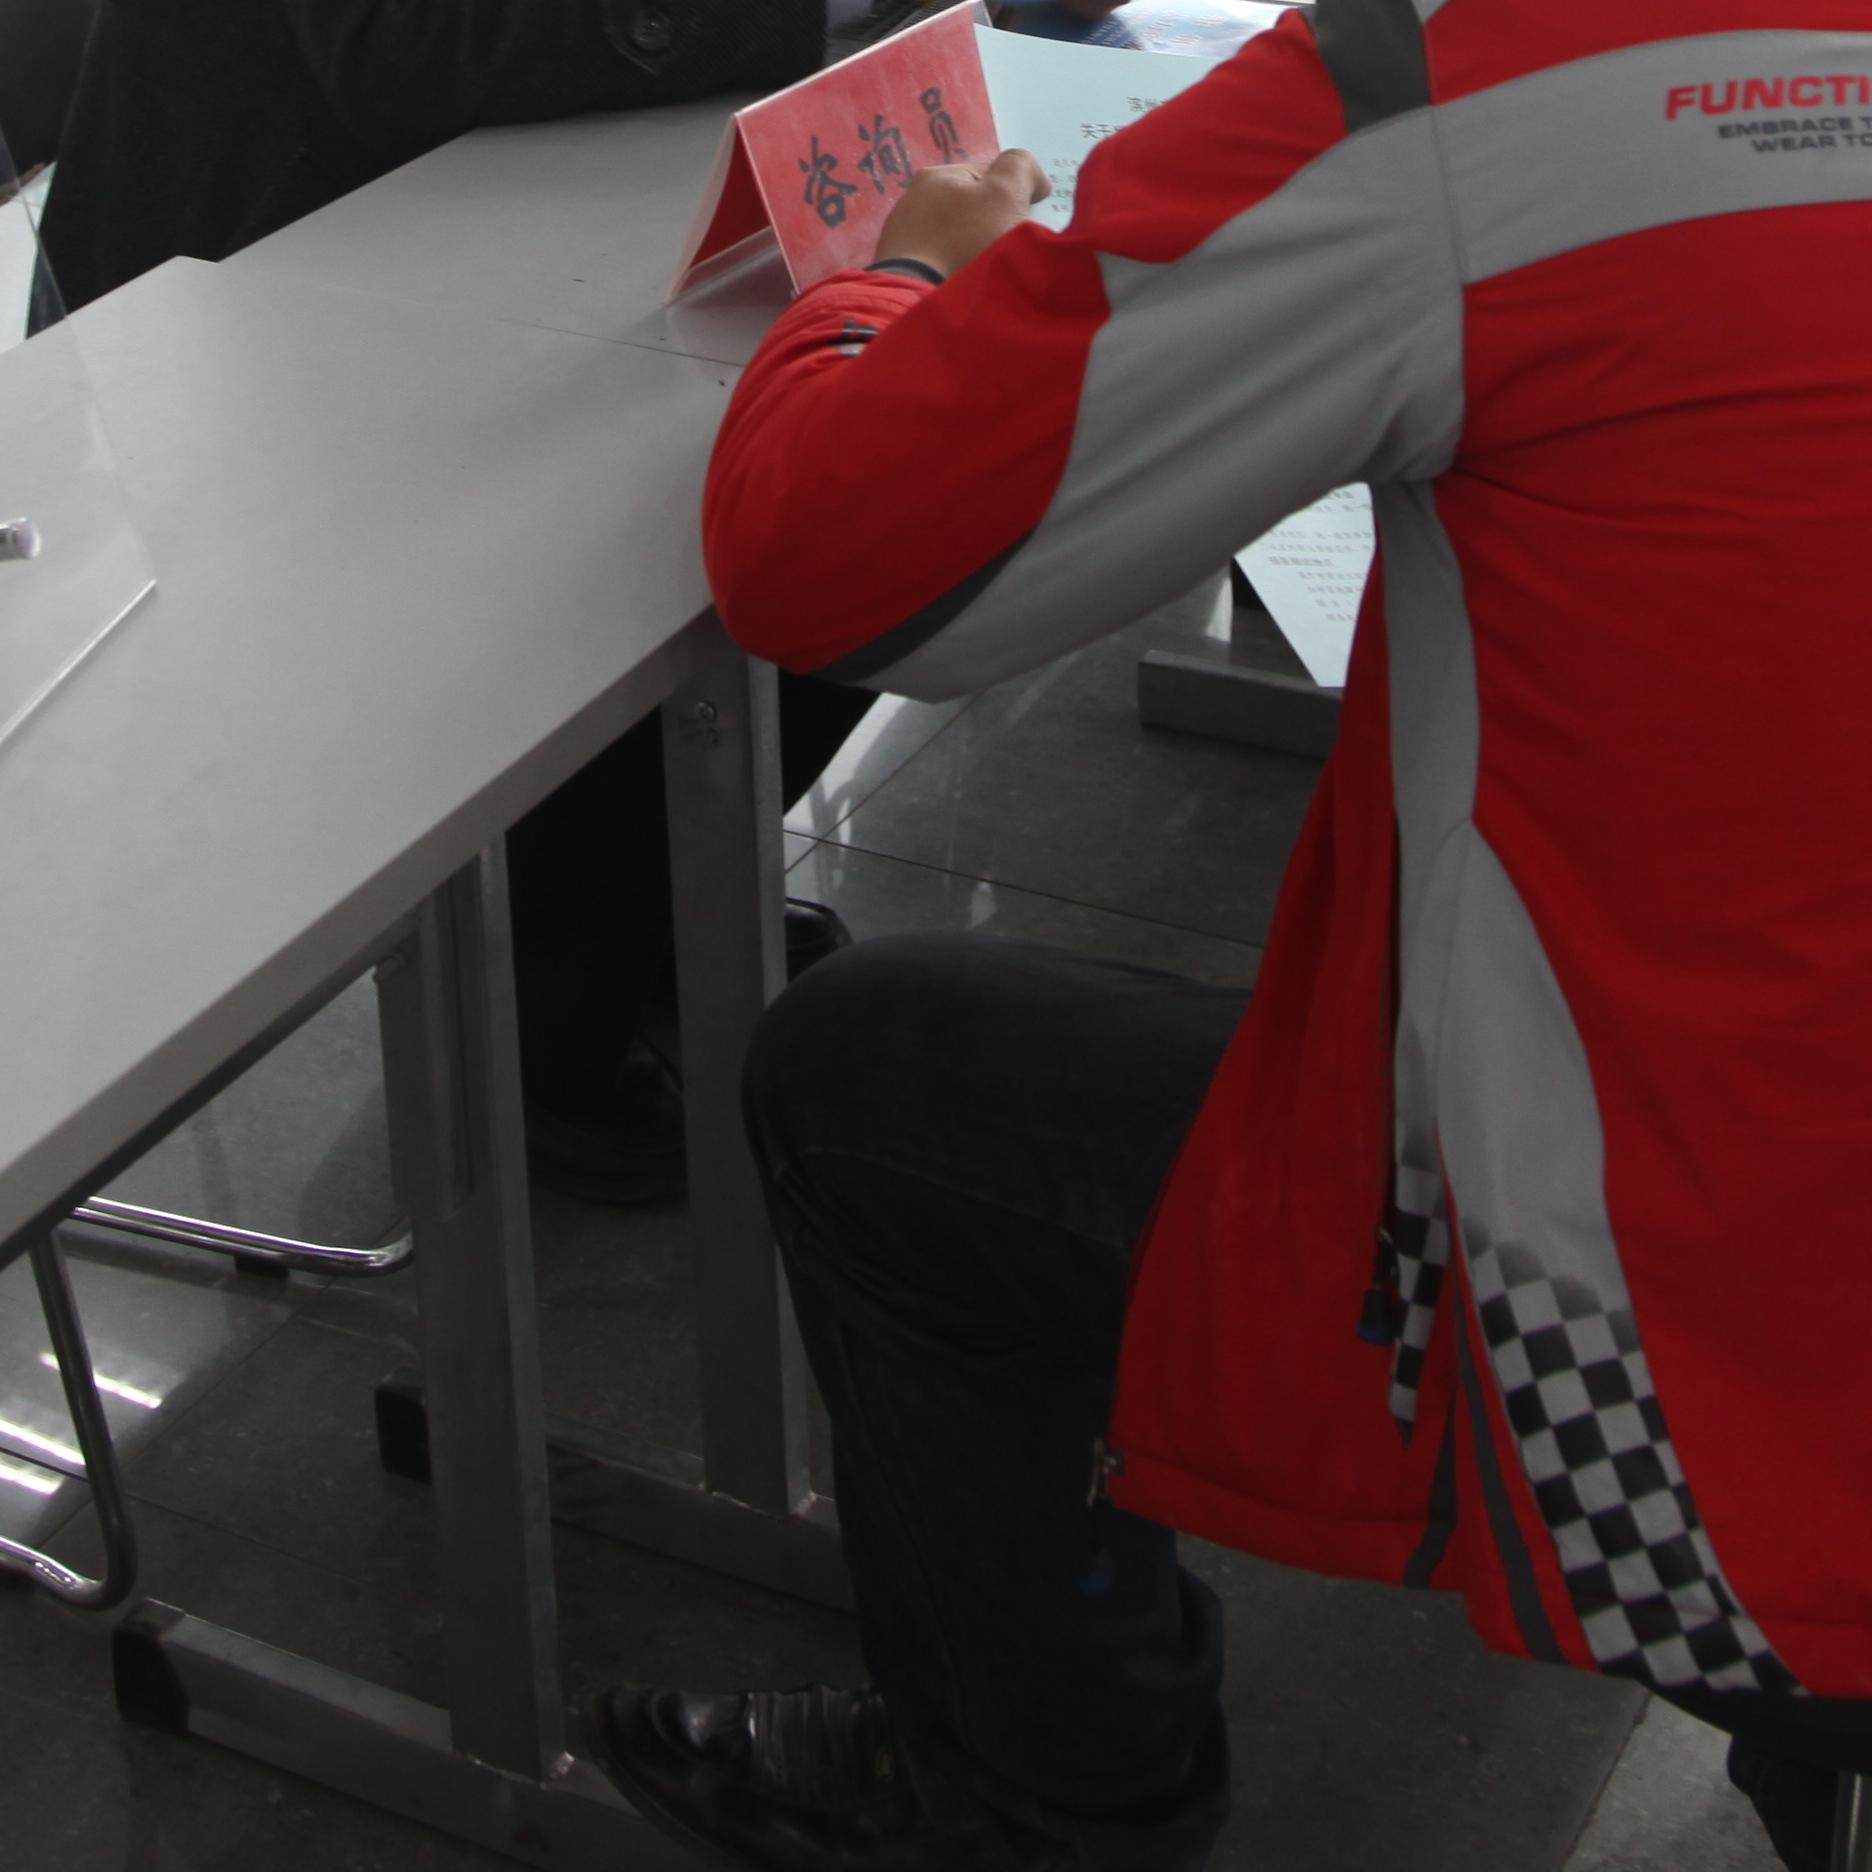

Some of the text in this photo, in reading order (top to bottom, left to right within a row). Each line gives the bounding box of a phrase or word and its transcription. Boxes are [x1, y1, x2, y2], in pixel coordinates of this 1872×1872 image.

[1717, 116, 1855, 140] EMBRACE
[1751, 134, 1837, 153] WEAR
[798, 87, 970, 229] 咨询员
